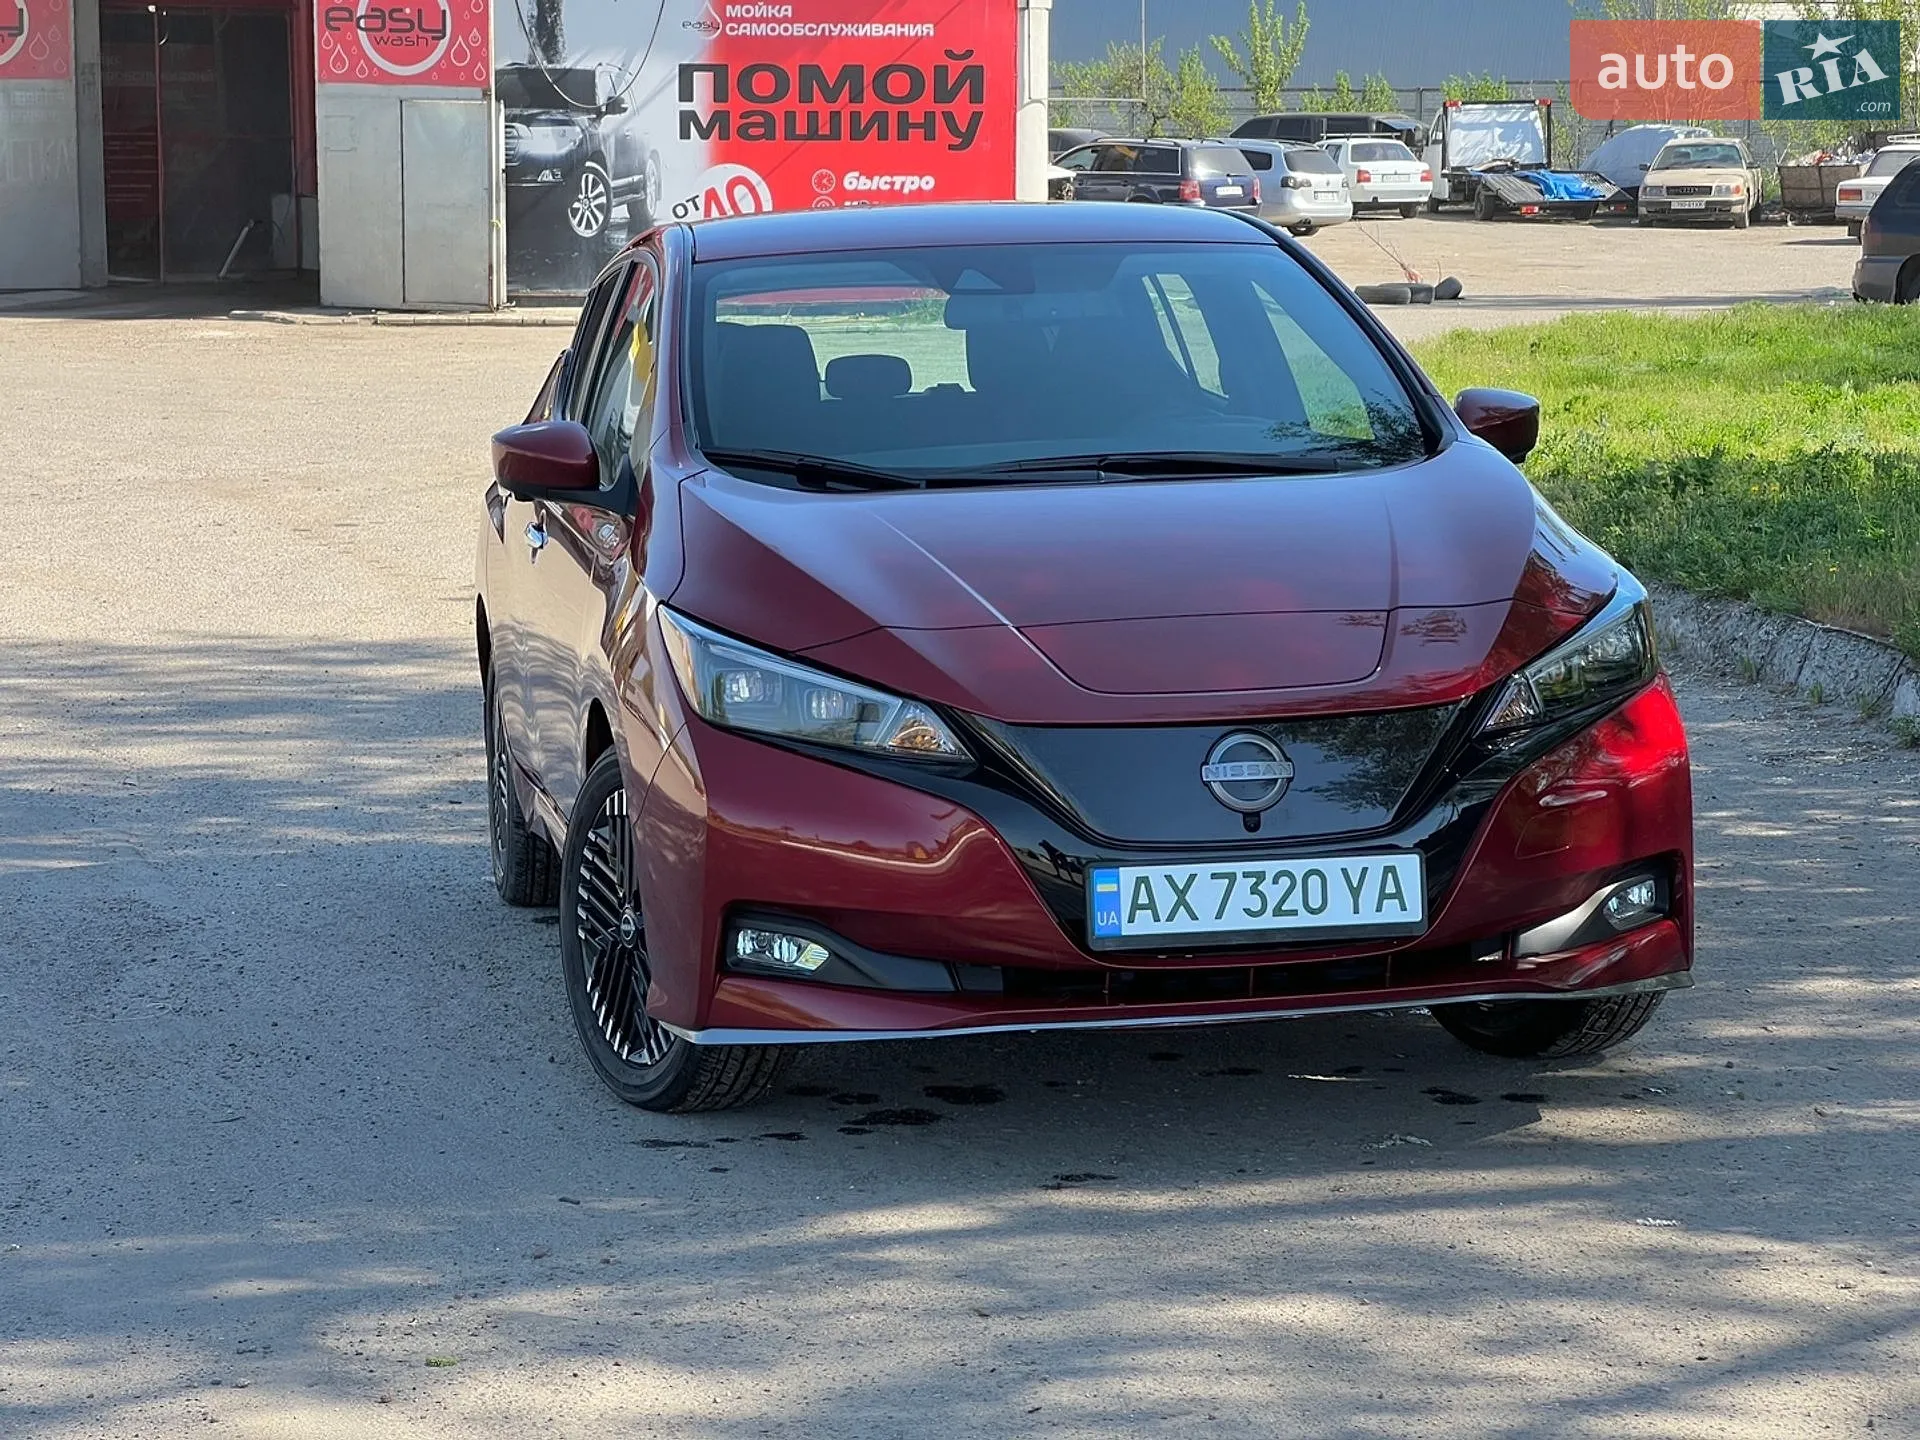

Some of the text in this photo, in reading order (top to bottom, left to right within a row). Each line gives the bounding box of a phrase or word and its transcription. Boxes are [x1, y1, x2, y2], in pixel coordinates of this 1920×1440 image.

[726, 3, 792, 18] МОЙКА
[325, 6, 446, 41] easy
[726, 23, 934, 37] САМООБСЛУЖИВАНИЯ
[374, 34, 429, 47] wash
[678, 110, 984, 151] машину
[843, 171, 935, 194] быстро
[1205, 762, 1293, 780] NISSAN
[1127, 865, 1408, 924] AX 7320 YA
[1097, 911, 1119, 927] UA
